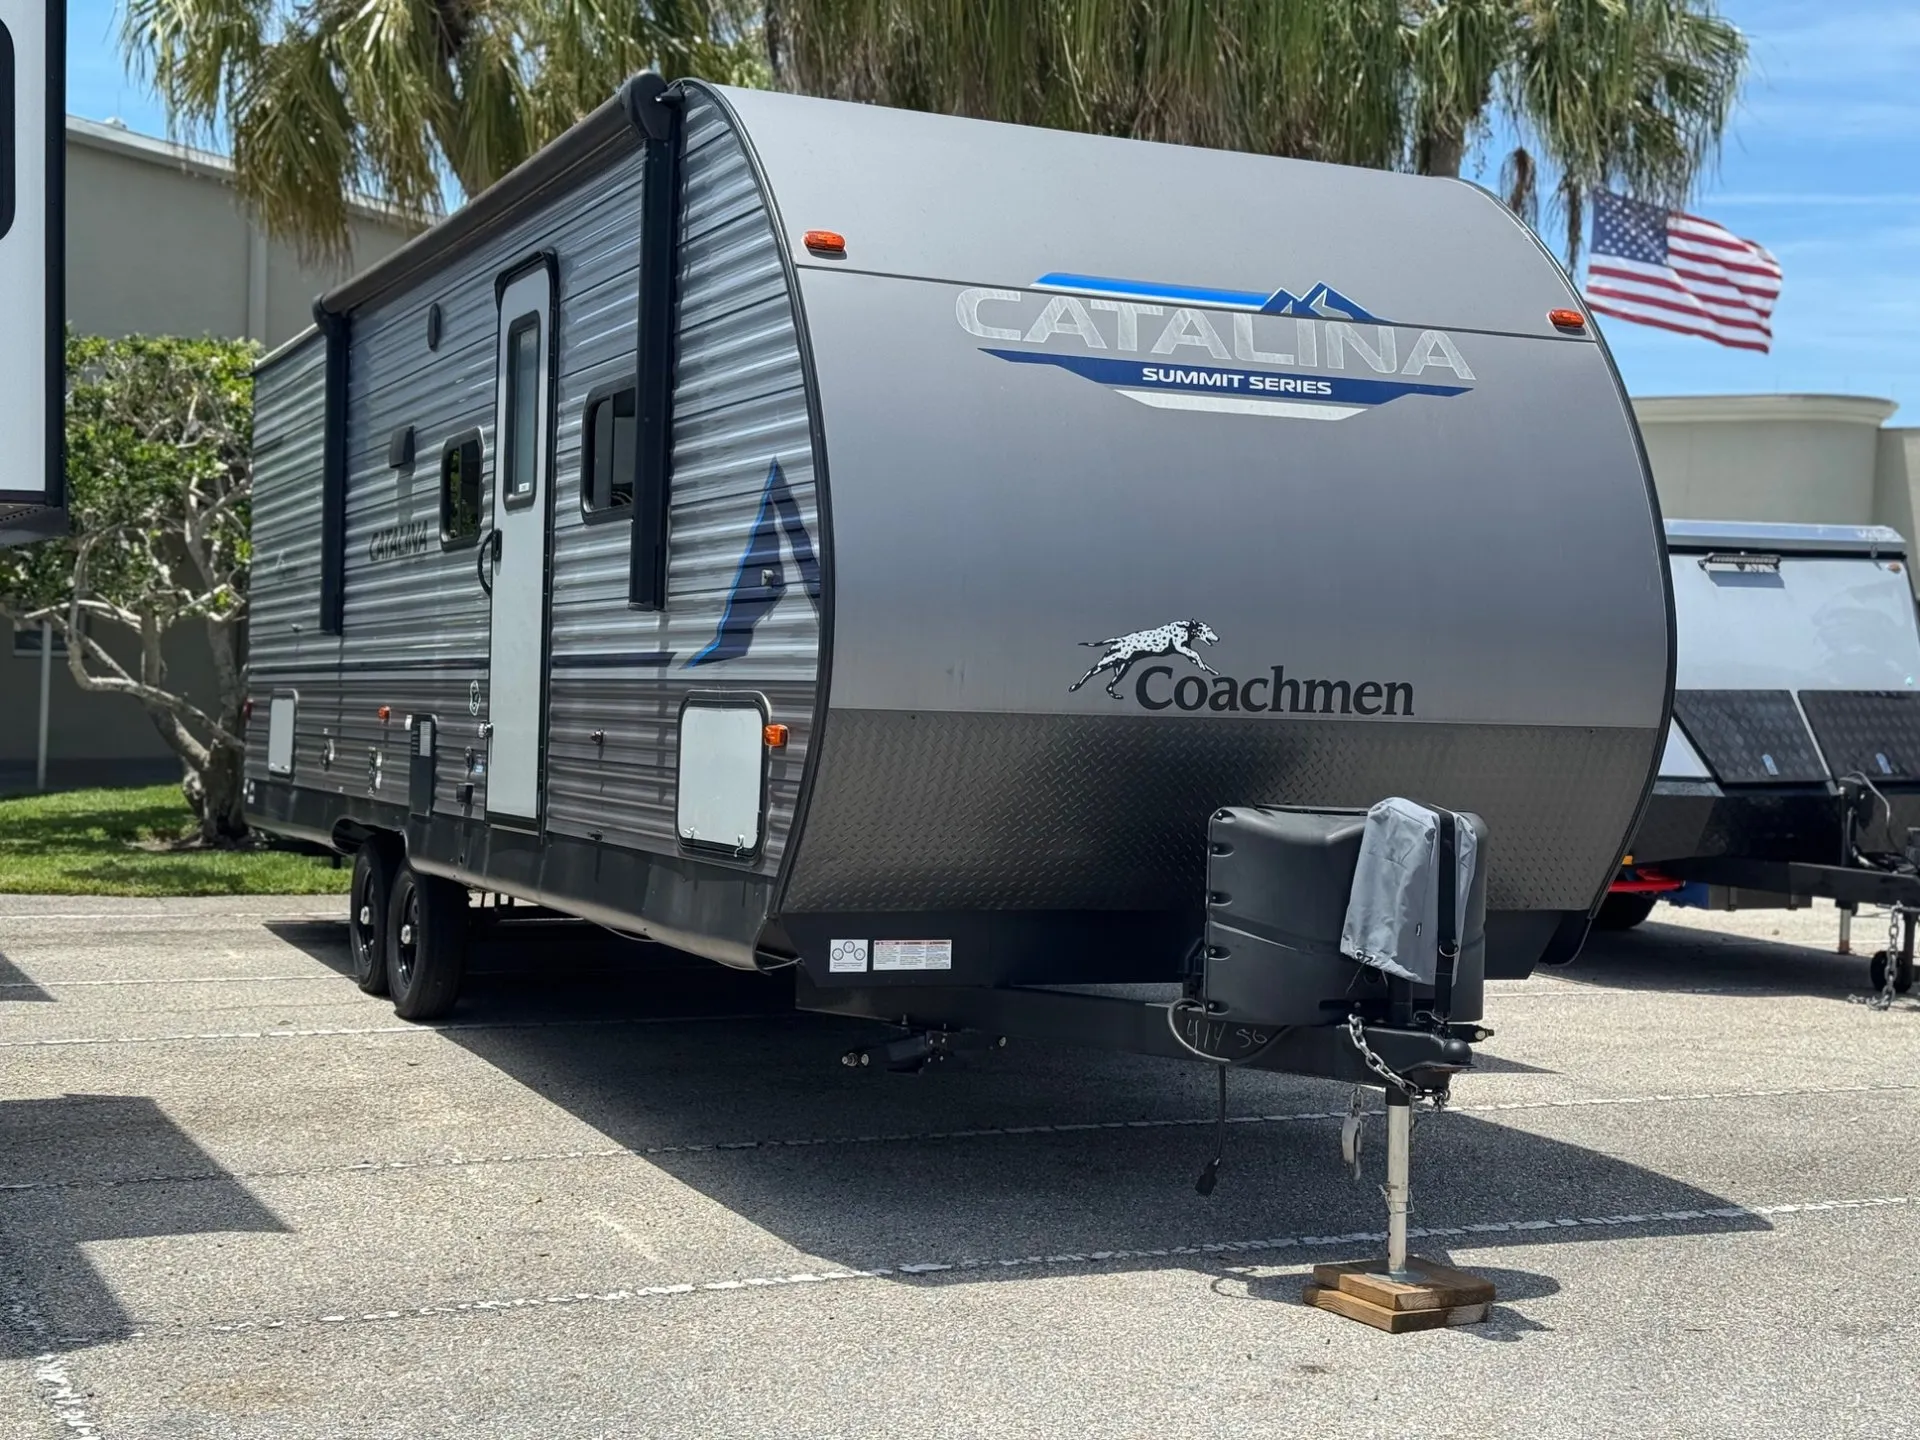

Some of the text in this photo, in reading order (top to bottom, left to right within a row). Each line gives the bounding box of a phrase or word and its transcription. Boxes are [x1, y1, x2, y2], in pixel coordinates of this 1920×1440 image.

[954, 287, 1476, 380] CATALINA
[1141, 367, 1332, 396] SUMMIT SERIES
[369, 519, 428, 561] CATALINA
[1135, 665, 1415, 716] Coachmen
